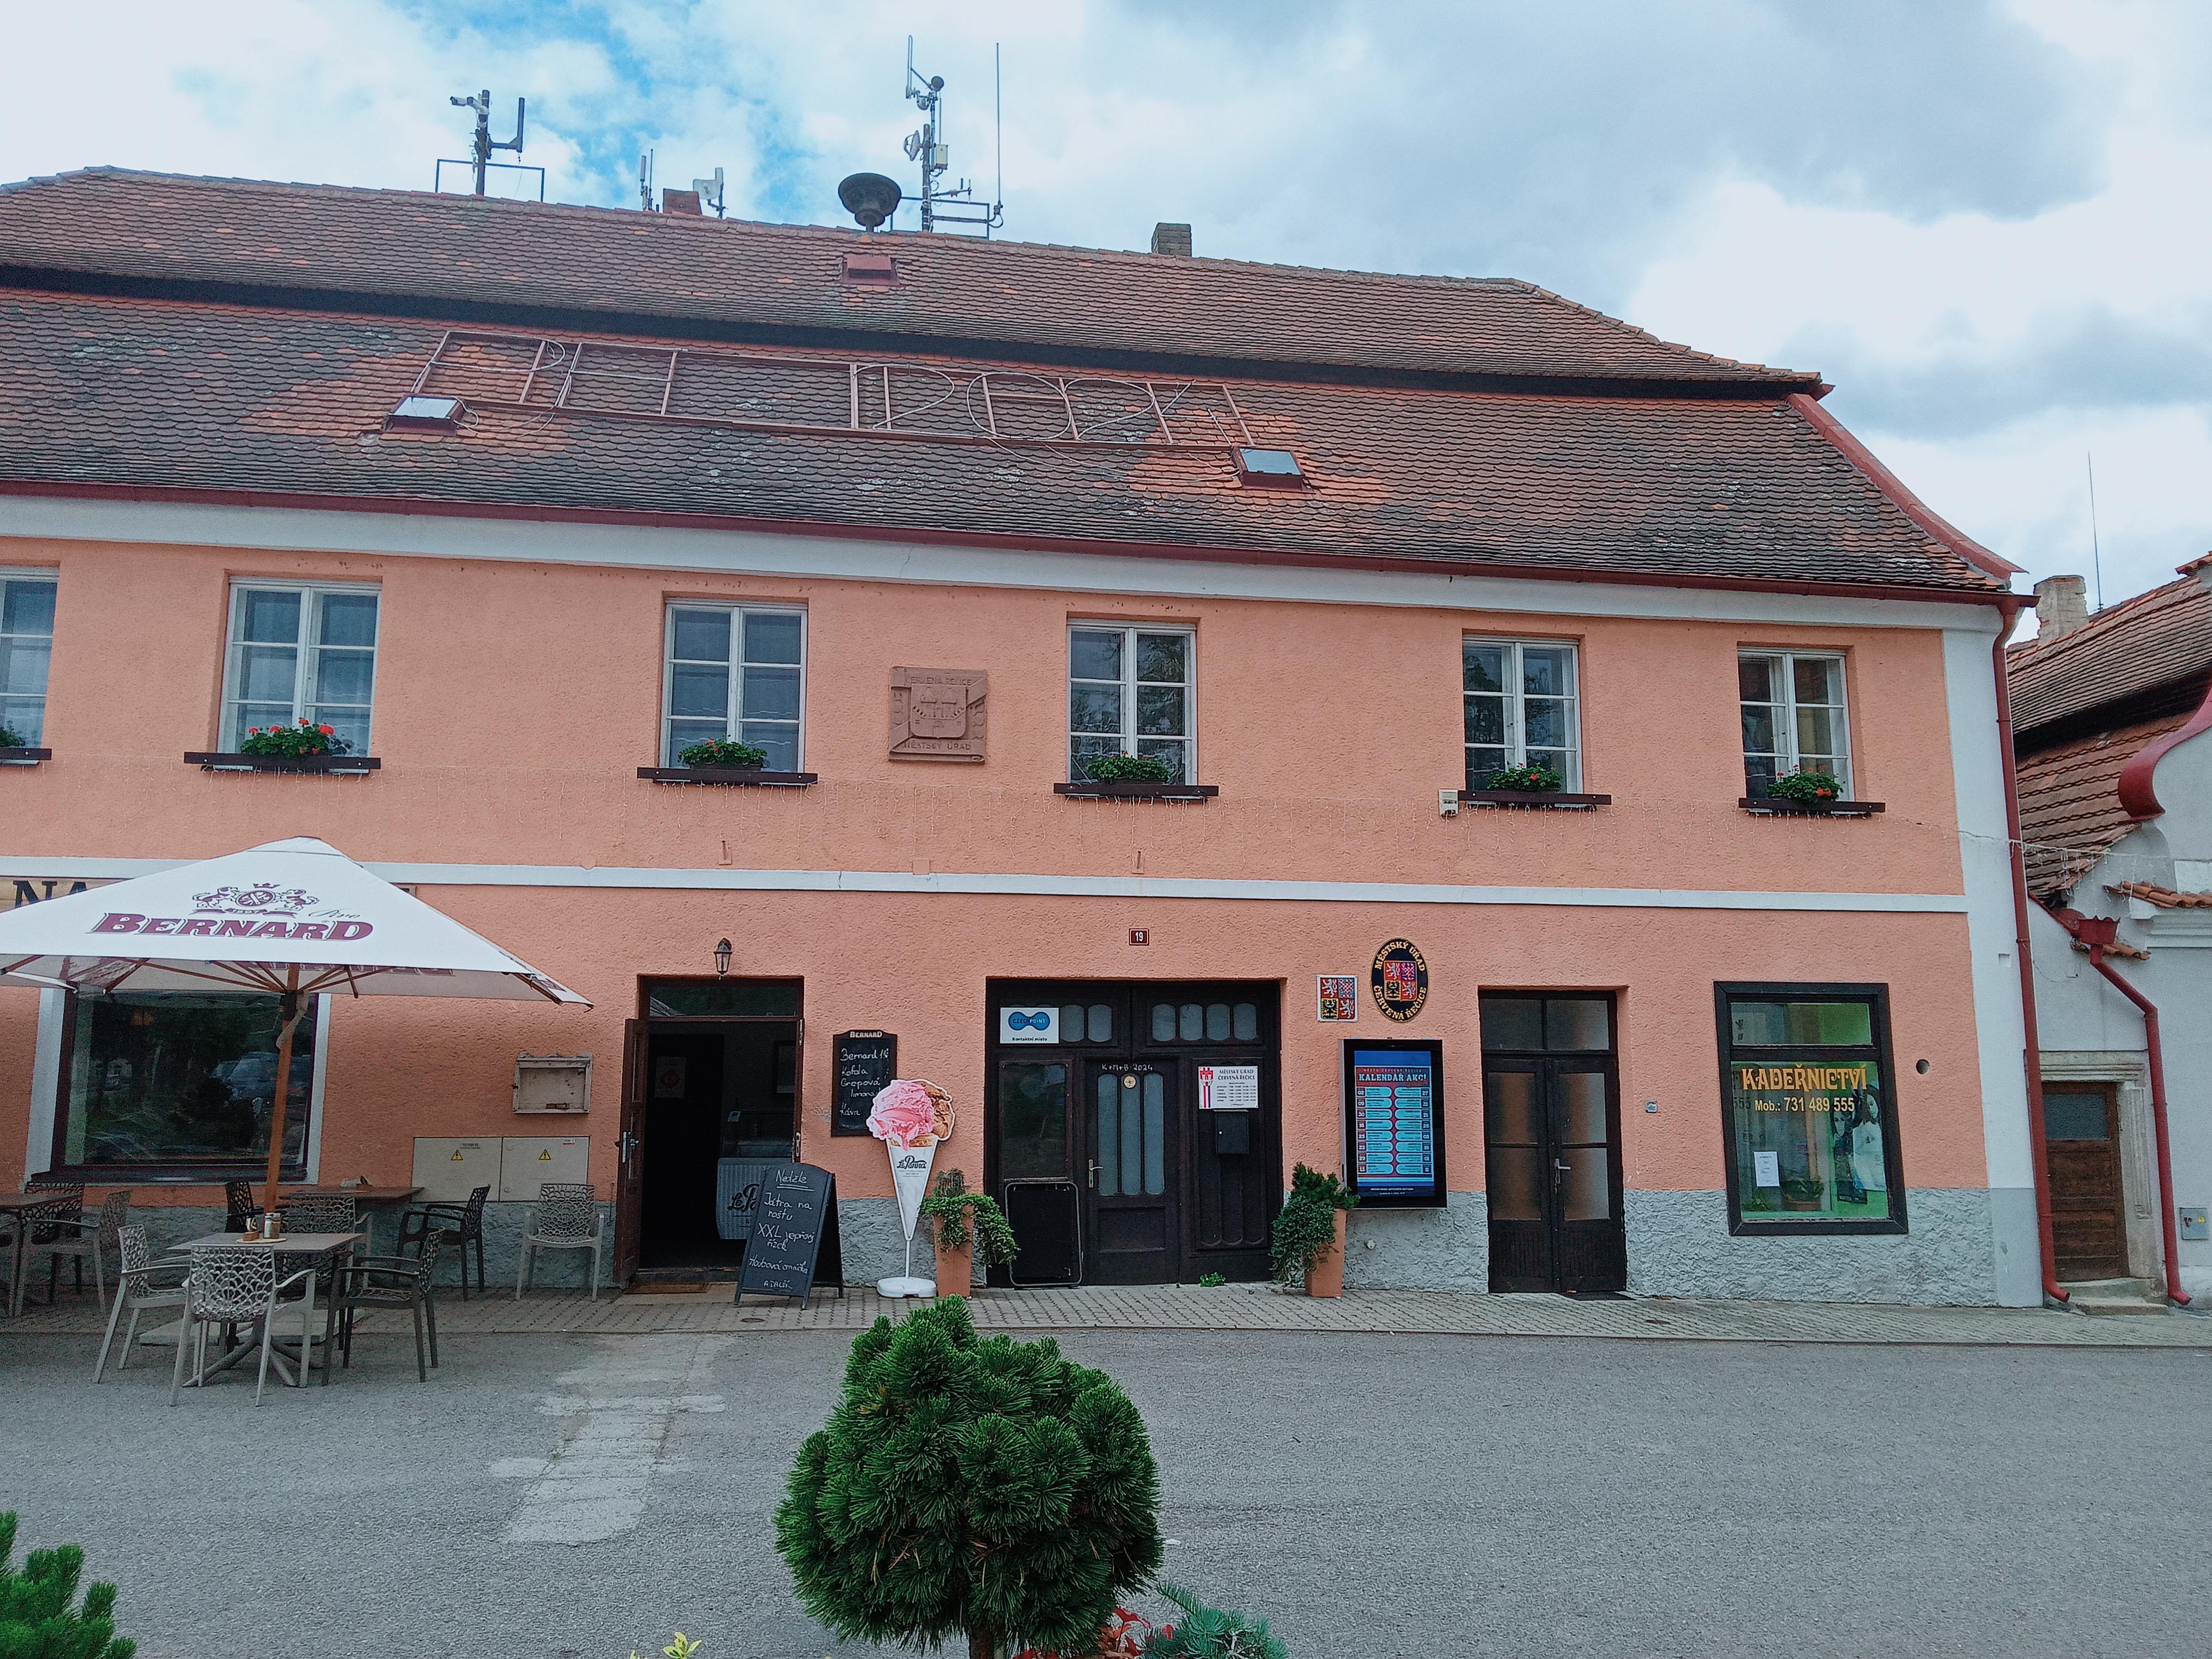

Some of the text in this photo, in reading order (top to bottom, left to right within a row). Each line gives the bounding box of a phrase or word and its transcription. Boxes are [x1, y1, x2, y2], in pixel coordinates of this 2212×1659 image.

[88, 912, 374, 941] BERNARD
[1135, 932, 1143, 942] 19
[1375, 941, 1425, 972] MĚSTSKÝ ÚŘAD
[1374, 985, 1427, 1020] ČERVENÁ ŘEČICE
[840, 1048, 878, 1061] Bernard
[841, 1065, 868, 1077] Kofola
[1133, 1063, 1153, 1071] 2024
[841, 1077, 880, 1089] Grepová
[1358, 1073, 1404, 1082] KALENDÁŘ
[1741, 1063, 1867, 1092] KADEŘNICTVÍ
[1755, 1097, 1855, 1112] Mob.: 731 489 555
[904, 1155, 927, 1170] Panna
[764, 1192, 812, 1210] Játra na
[757, 1222, 782, 1238] XXL
